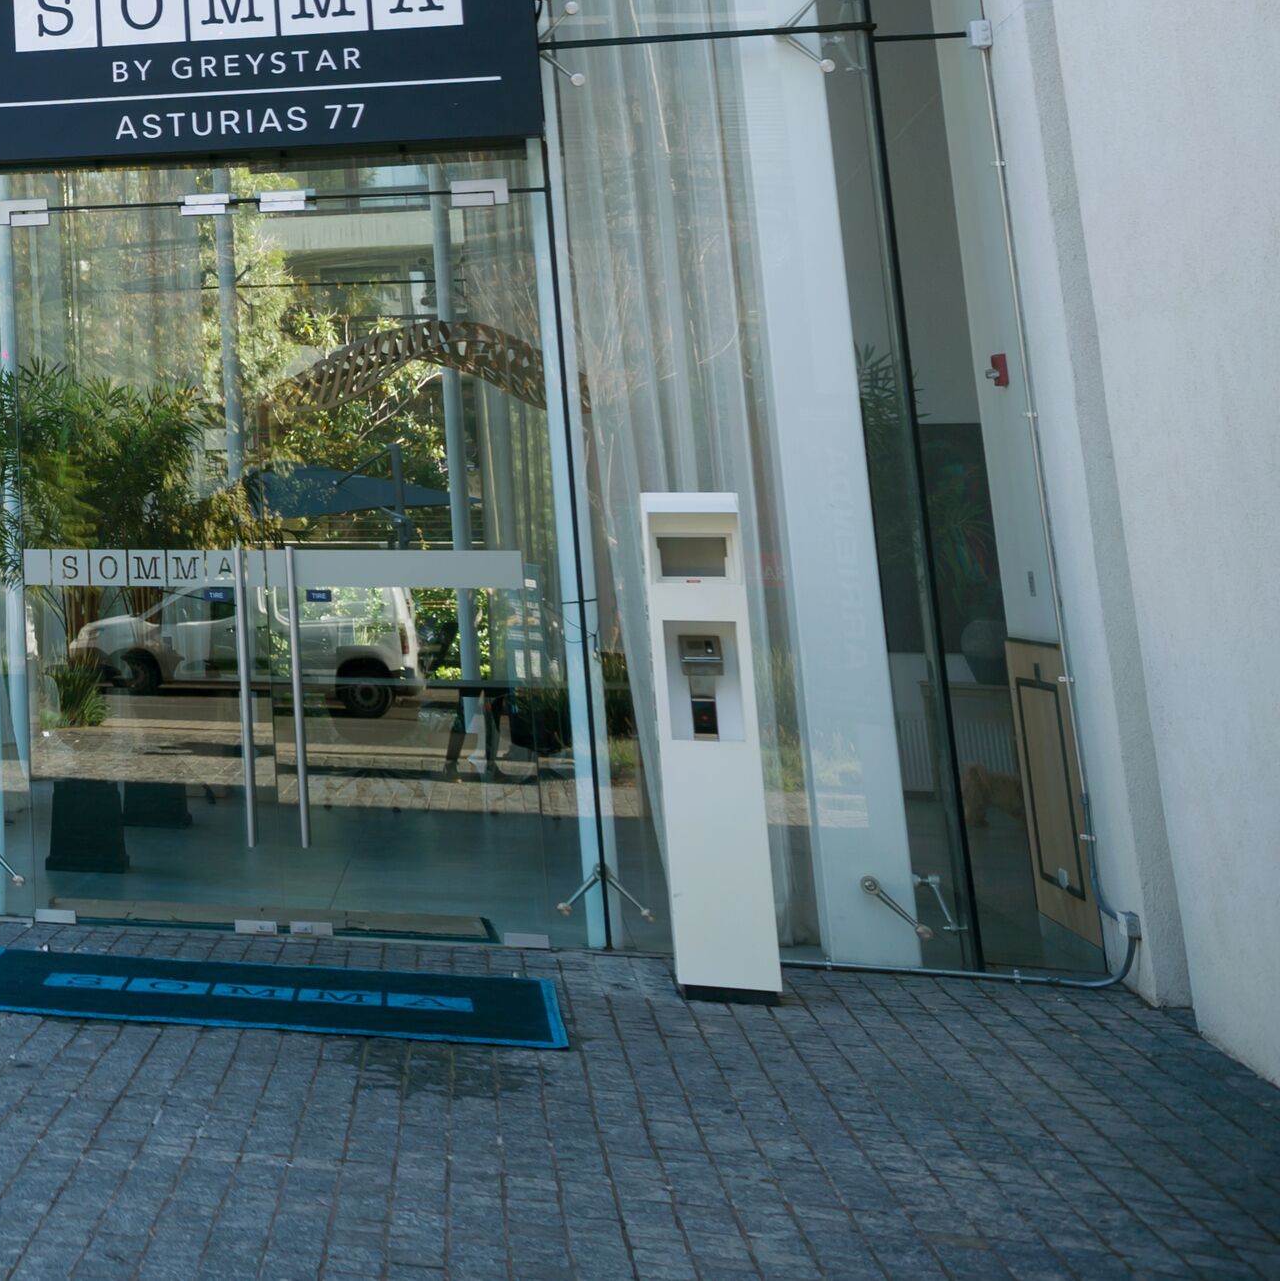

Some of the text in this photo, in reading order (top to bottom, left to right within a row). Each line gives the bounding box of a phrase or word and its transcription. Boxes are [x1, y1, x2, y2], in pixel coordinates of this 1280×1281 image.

[111, 47, 363, 83] BY GREYSTAR
[114, 102, 365, 141] ASTURIAS 77
[62, 555, 236, 582] SOMMA
[209, 591, 224, 599] TIRE
[312, 592, 327, 600] TIRE
[66, 976, 455, 1009] SOMMA
